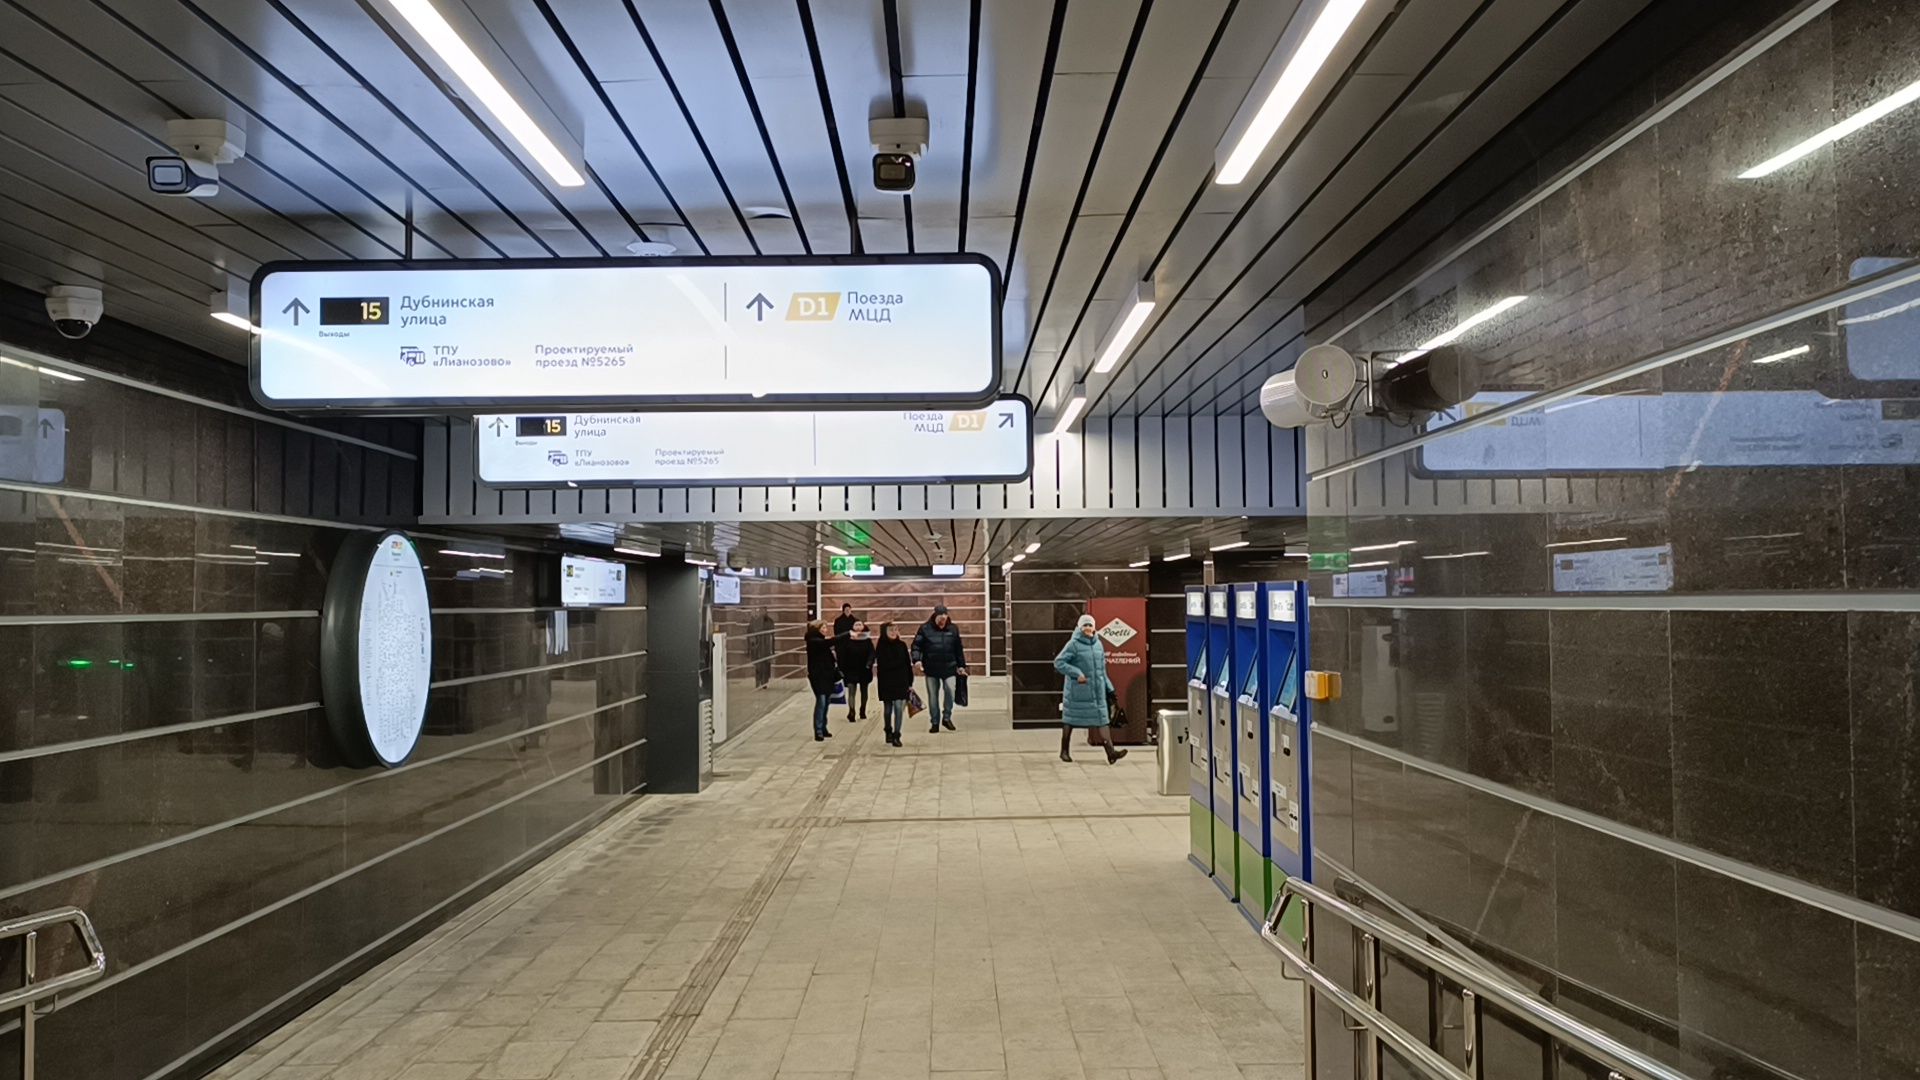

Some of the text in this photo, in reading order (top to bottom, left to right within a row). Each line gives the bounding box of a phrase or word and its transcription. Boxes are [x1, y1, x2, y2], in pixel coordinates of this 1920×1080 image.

[400, 295, 495, 311] Дубнинская
[847, 291, 904, 306] Поезда
[360, 302, 382, 320] 15
[797, 297, 830, 317] D1
[400, 314, 447, 328] улица
[848, 308, 892, 323] МЦД
[433, 345, 459, 356] ТПУ
[535, 344, 634, 357] Проектируемый
[432, 357, 512, 367] «Лианозово»
[535, 356, 626, 368] проезд №5265
[573, 415, 641, 427] Дубнинская
[903, 412, 944, 421] Поезда
[956, 414, 979, 429] D1
[545, 419, 561, 433] 15
[914, 423, 944, 433] МЦД
[574, 428, 607, 439] улица
[575, 449, 593, 457] ТПУ
